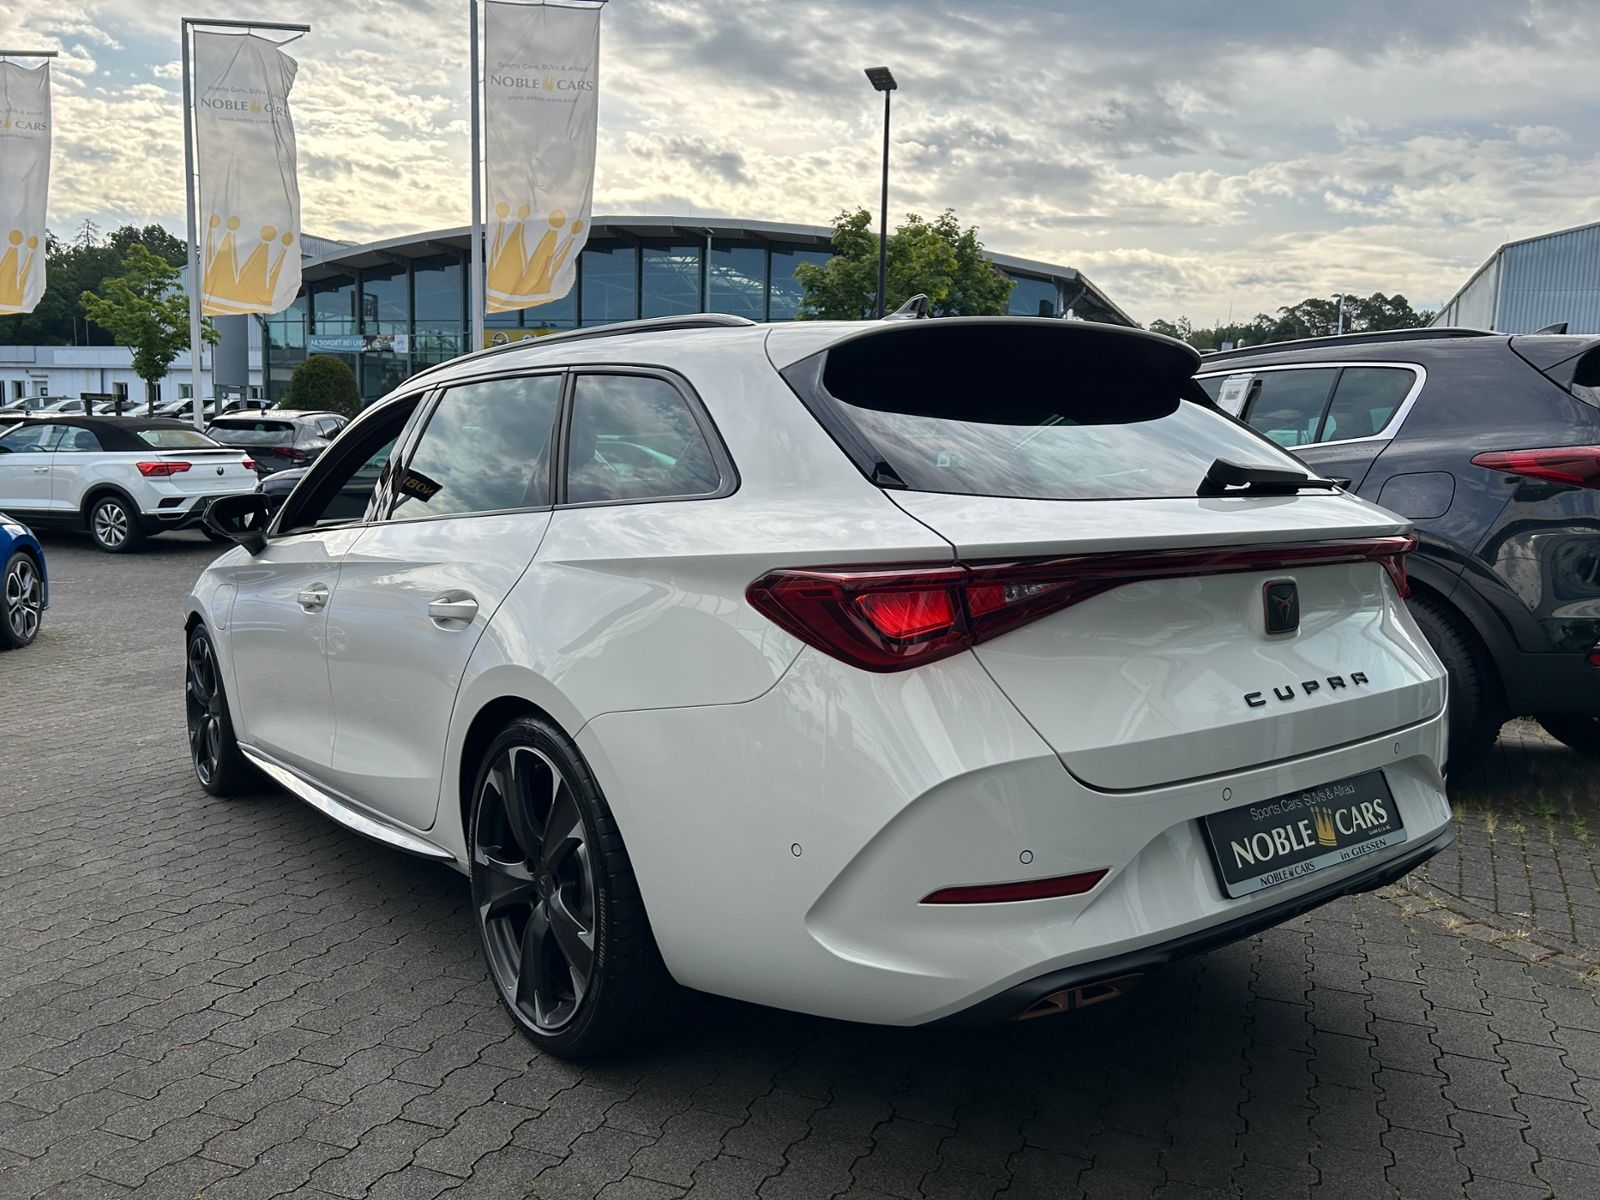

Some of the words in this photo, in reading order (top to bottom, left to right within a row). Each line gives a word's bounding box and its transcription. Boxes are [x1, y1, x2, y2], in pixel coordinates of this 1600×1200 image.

[490, 74, 540, 89] NOBLE
[556, 80, 594, 92] CARS
[200, 97, 249, 111] NOBLE
[15, 120, 48, 131] CARS
[1244, 671, 1369, 708] CUPRA
[1250, 803, 1281, 822] Sports
[1303, 790, 1327, 806] SUVs
[1325, 787, 1334, 799] &
[1231, 819, 1316, 869] NOBLE
[1335, 798, 1388, 835] CARS
[1260, 869, 1288, 887] NOBLE
[1294, 861, 1316, 876] CARS
[1340, 851, 1350, 861] in
[1351, 838, 1387, 856] GIESSEN
